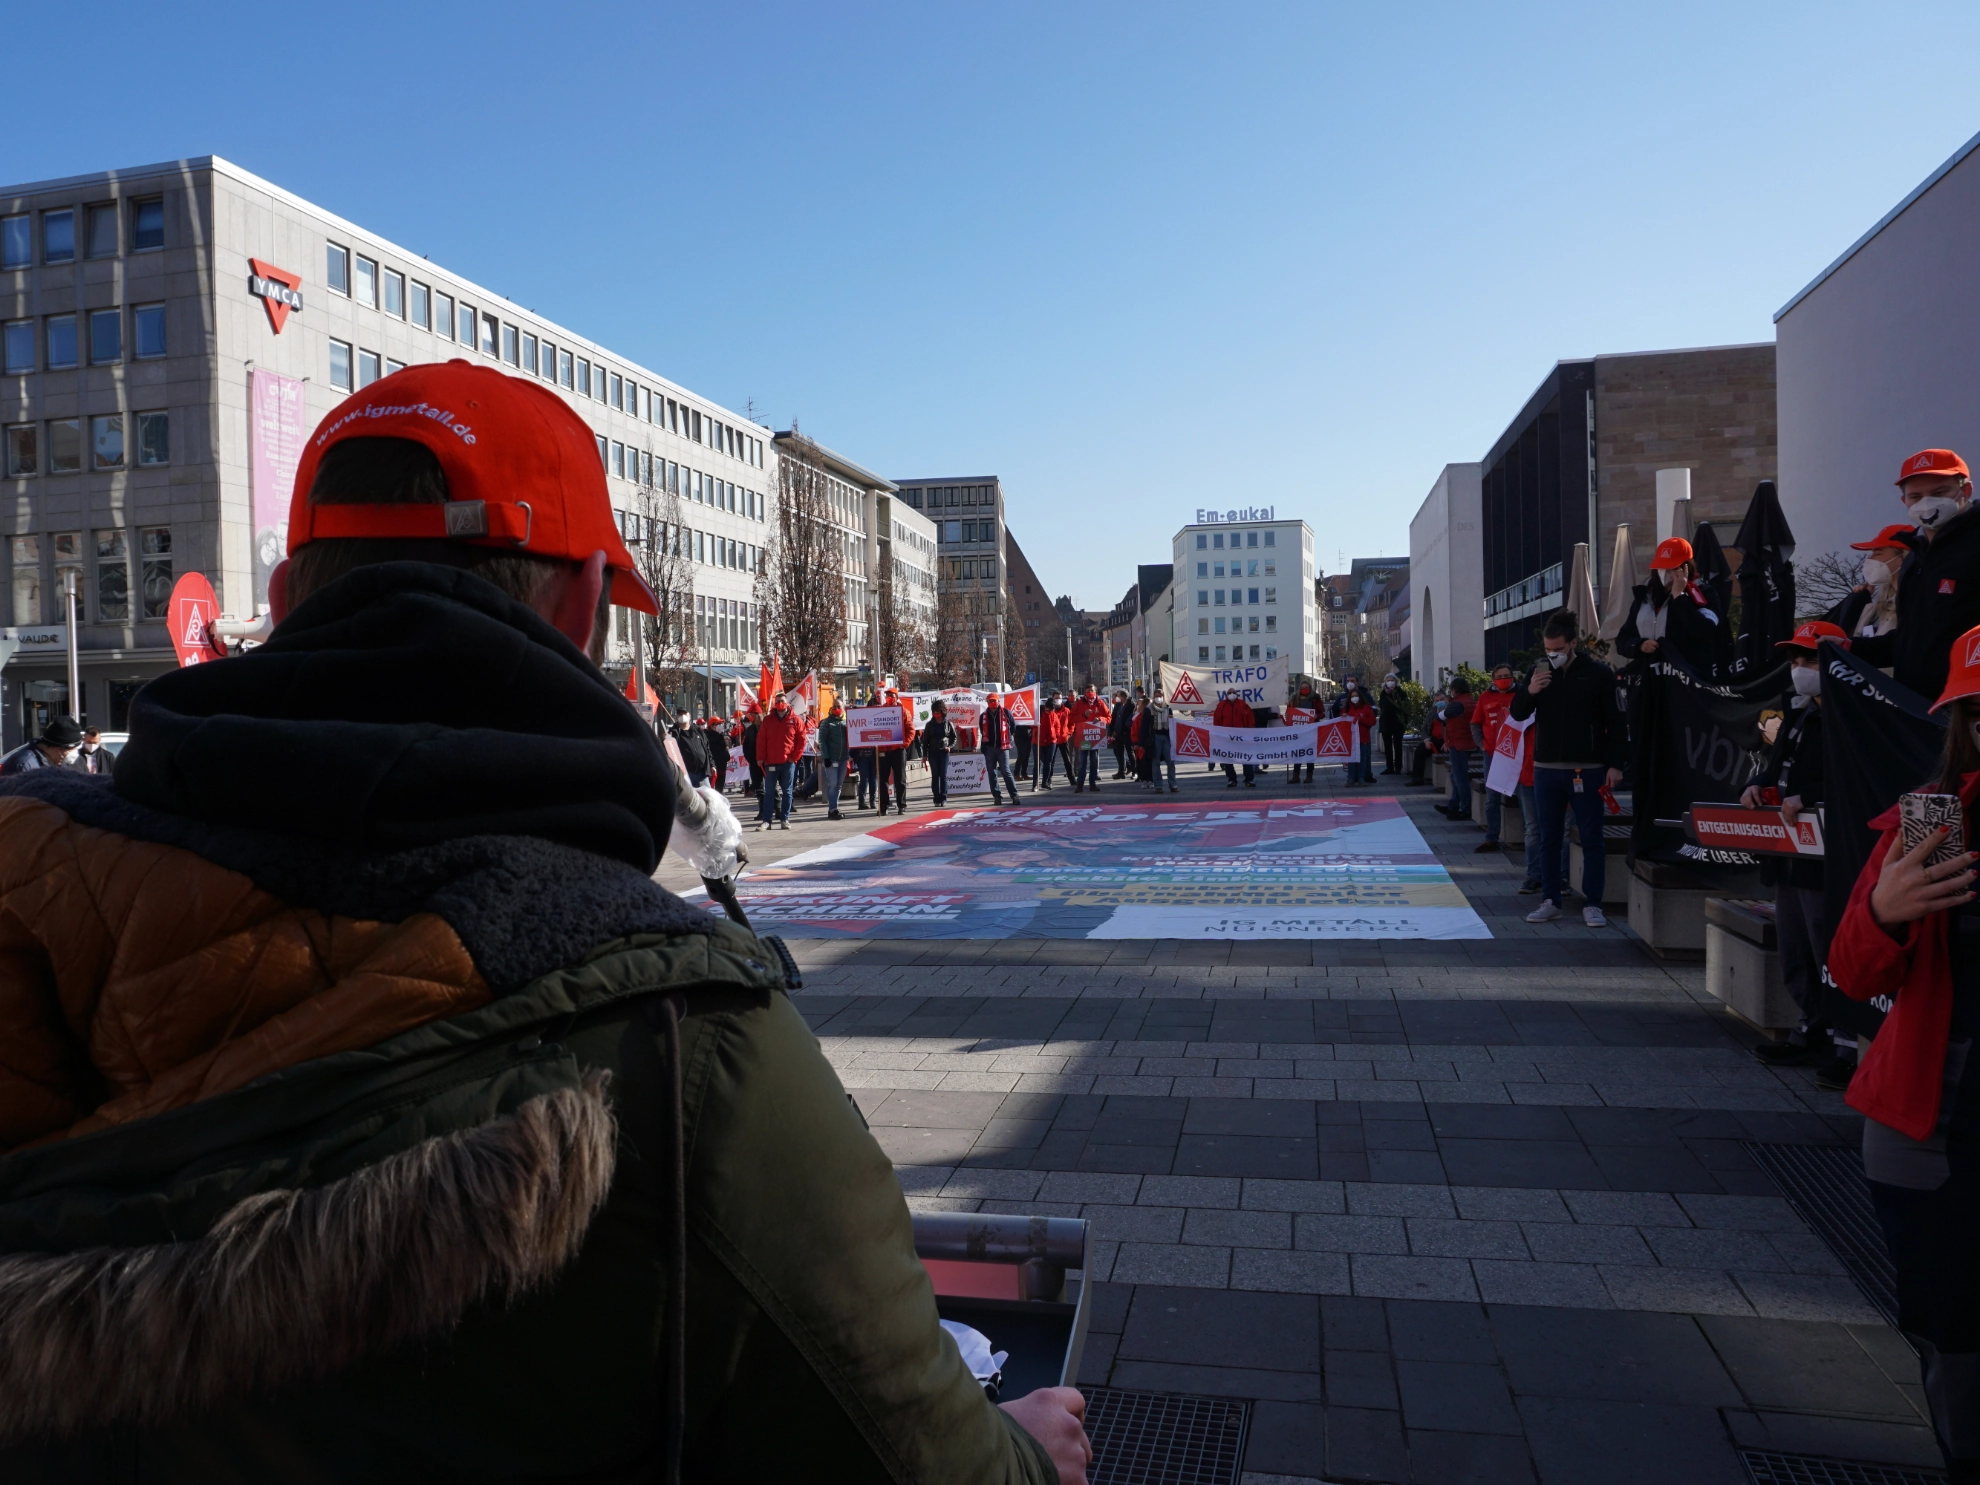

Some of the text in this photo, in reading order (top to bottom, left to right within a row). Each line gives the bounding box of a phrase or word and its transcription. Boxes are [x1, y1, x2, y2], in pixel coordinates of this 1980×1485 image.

[257, 278, 300, 308] YMCA
[316, 402, 477, 446] www.igmetall.de
[1211, 666, 1267, 684] TRAFO
[848, 718, 867, 728] WIR
[1253, 733, 1299, 742] Siemens
[1212, 747, 1314, 761] Mobility GmbH NBG
[1696, 820, 1786, 839] ENTGELTAUSGLEICH
